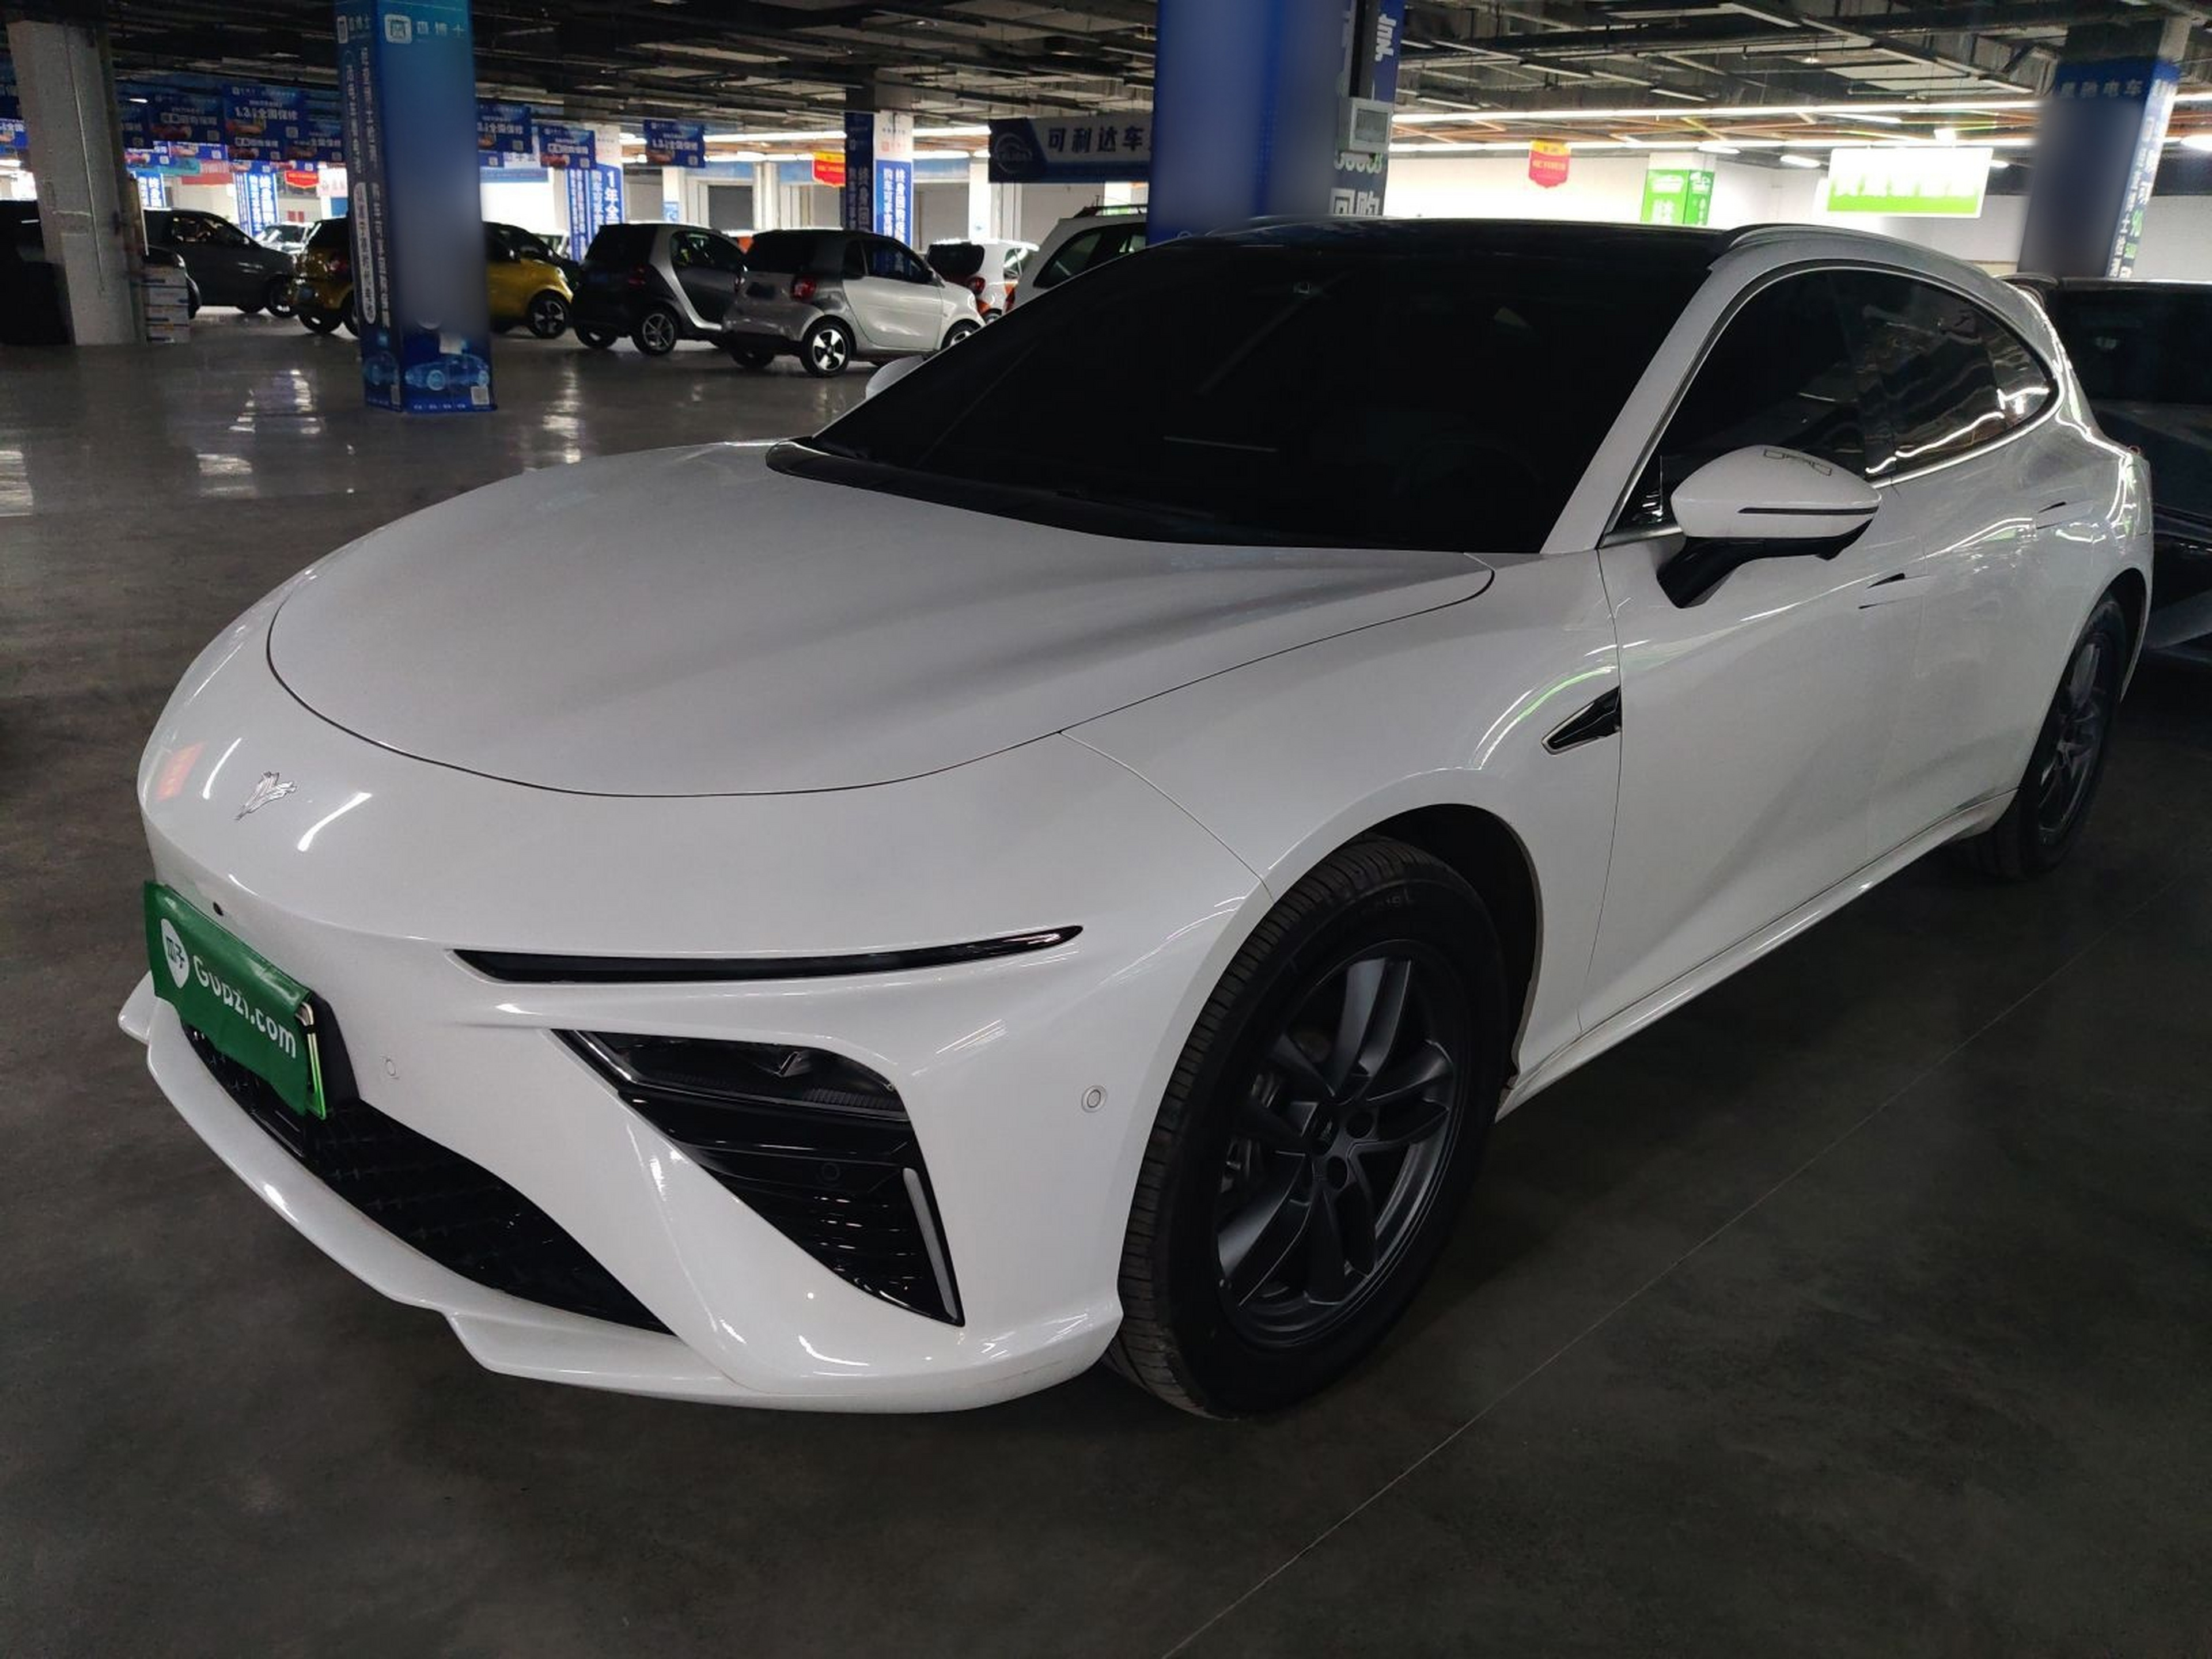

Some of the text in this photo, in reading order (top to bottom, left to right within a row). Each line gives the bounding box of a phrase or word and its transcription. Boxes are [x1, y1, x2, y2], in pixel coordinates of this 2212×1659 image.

[1048, 125, 1152, 153] 可利达车
[604, 171, 620, 224] 1年全
[193, 955, 296, 1059] Guazi.com
